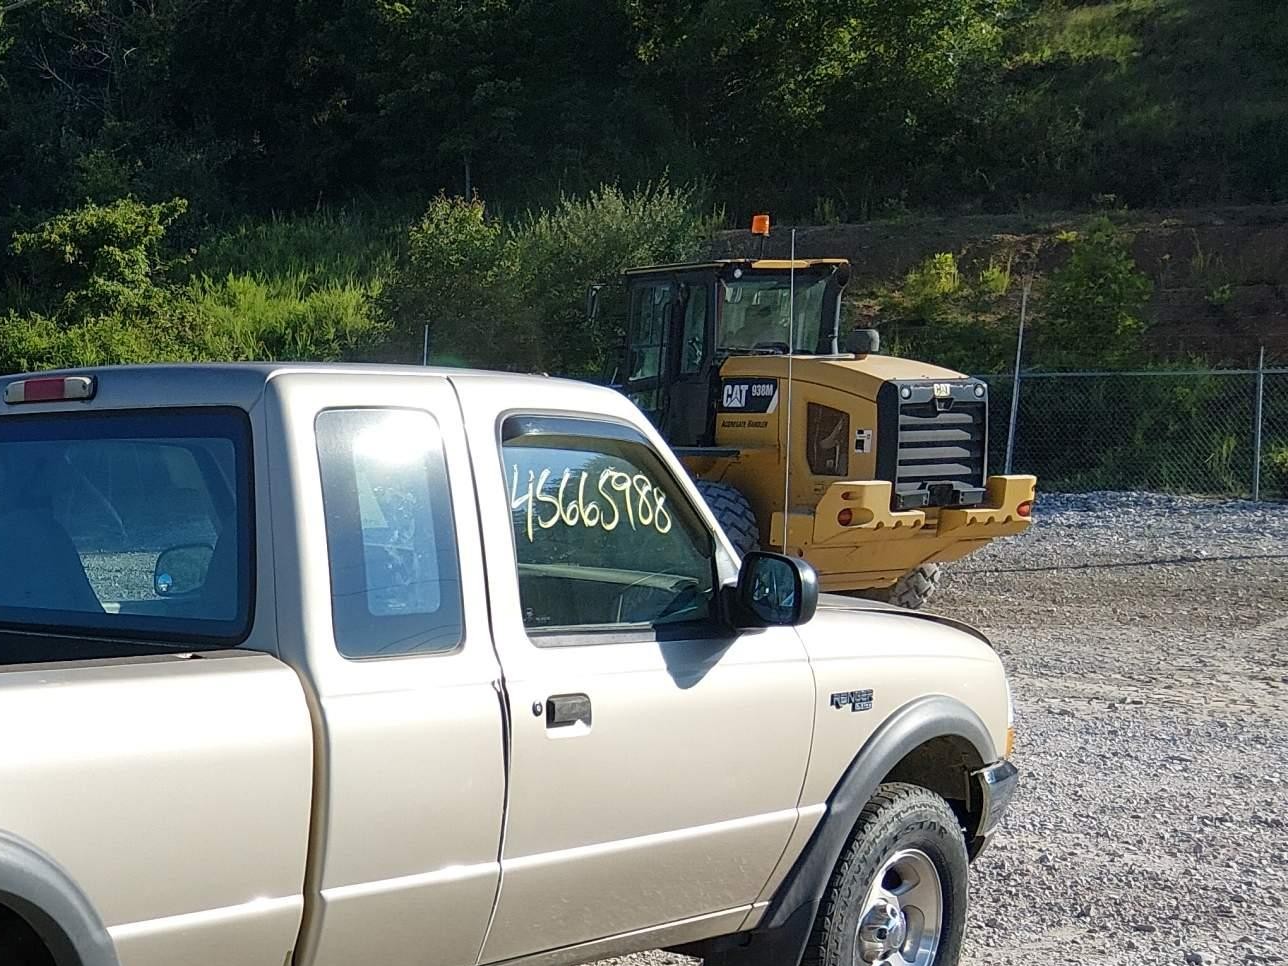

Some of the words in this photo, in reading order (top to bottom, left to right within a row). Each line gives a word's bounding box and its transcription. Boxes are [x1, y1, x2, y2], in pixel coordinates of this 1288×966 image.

[722, 384, 749, 408] CAT
[751, 384, 774, 397] 938M
[933, 383, 951, 398] CAT
[511, 463, 672, 543] 45665988
